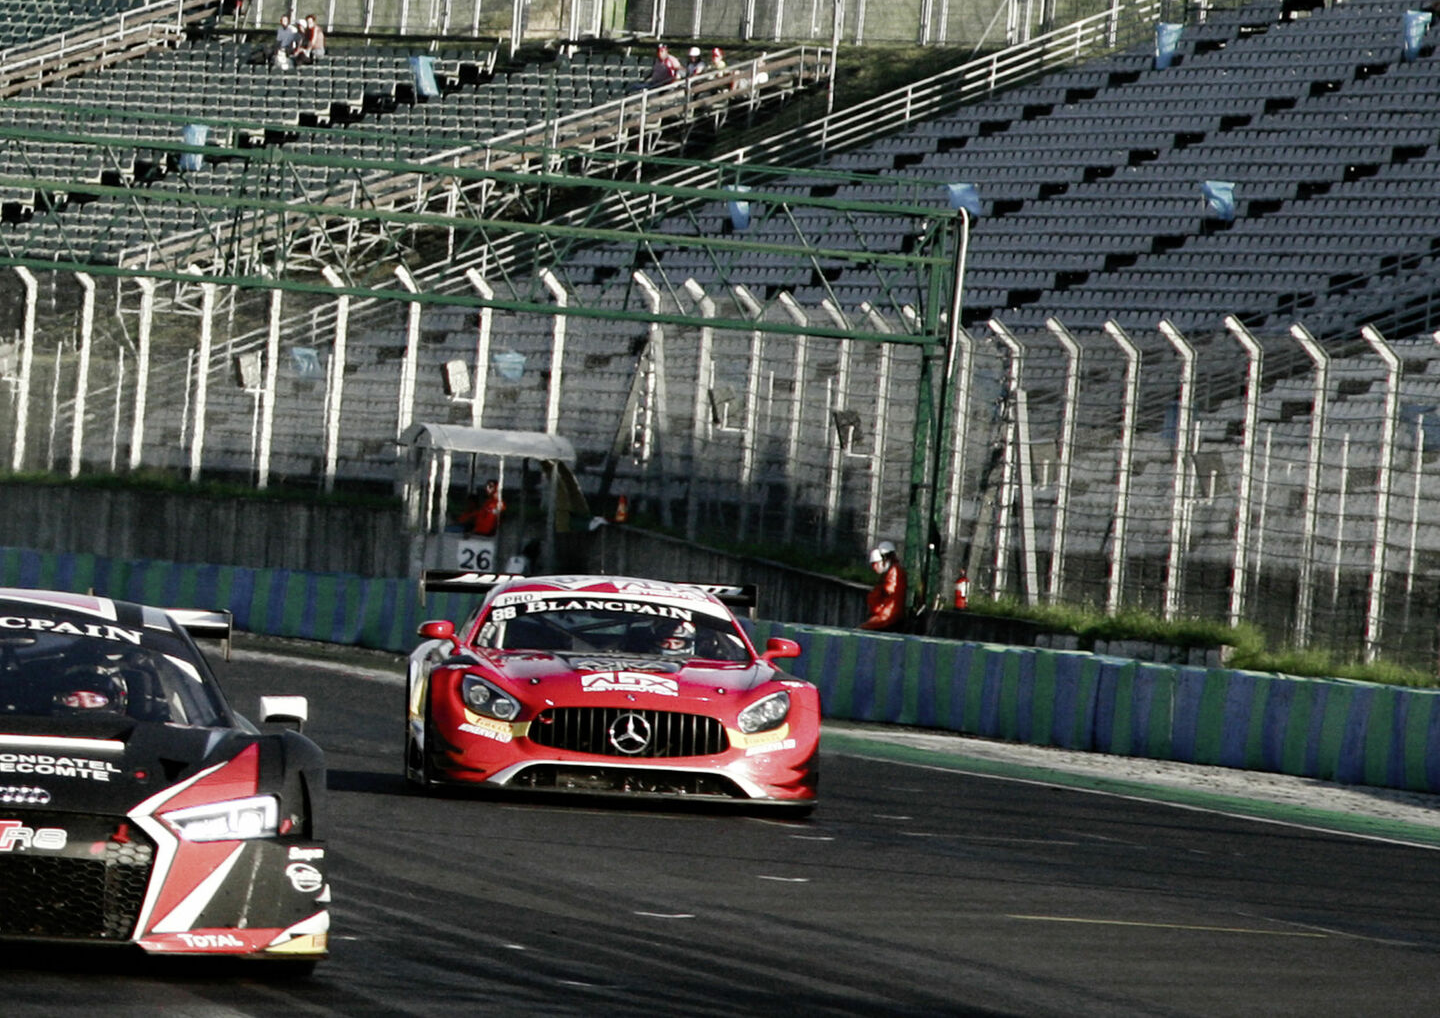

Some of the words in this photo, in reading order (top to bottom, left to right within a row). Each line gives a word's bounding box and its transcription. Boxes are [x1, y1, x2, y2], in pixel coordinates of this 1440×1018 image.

[461, 549, 491, 570] 26
[504, 593, 534, 605] PRO
[492, 606, 517, 622] 88
[526, 600, 693, 622] BLANCPAIN
[176, 934, 244, 948] TOTAL
